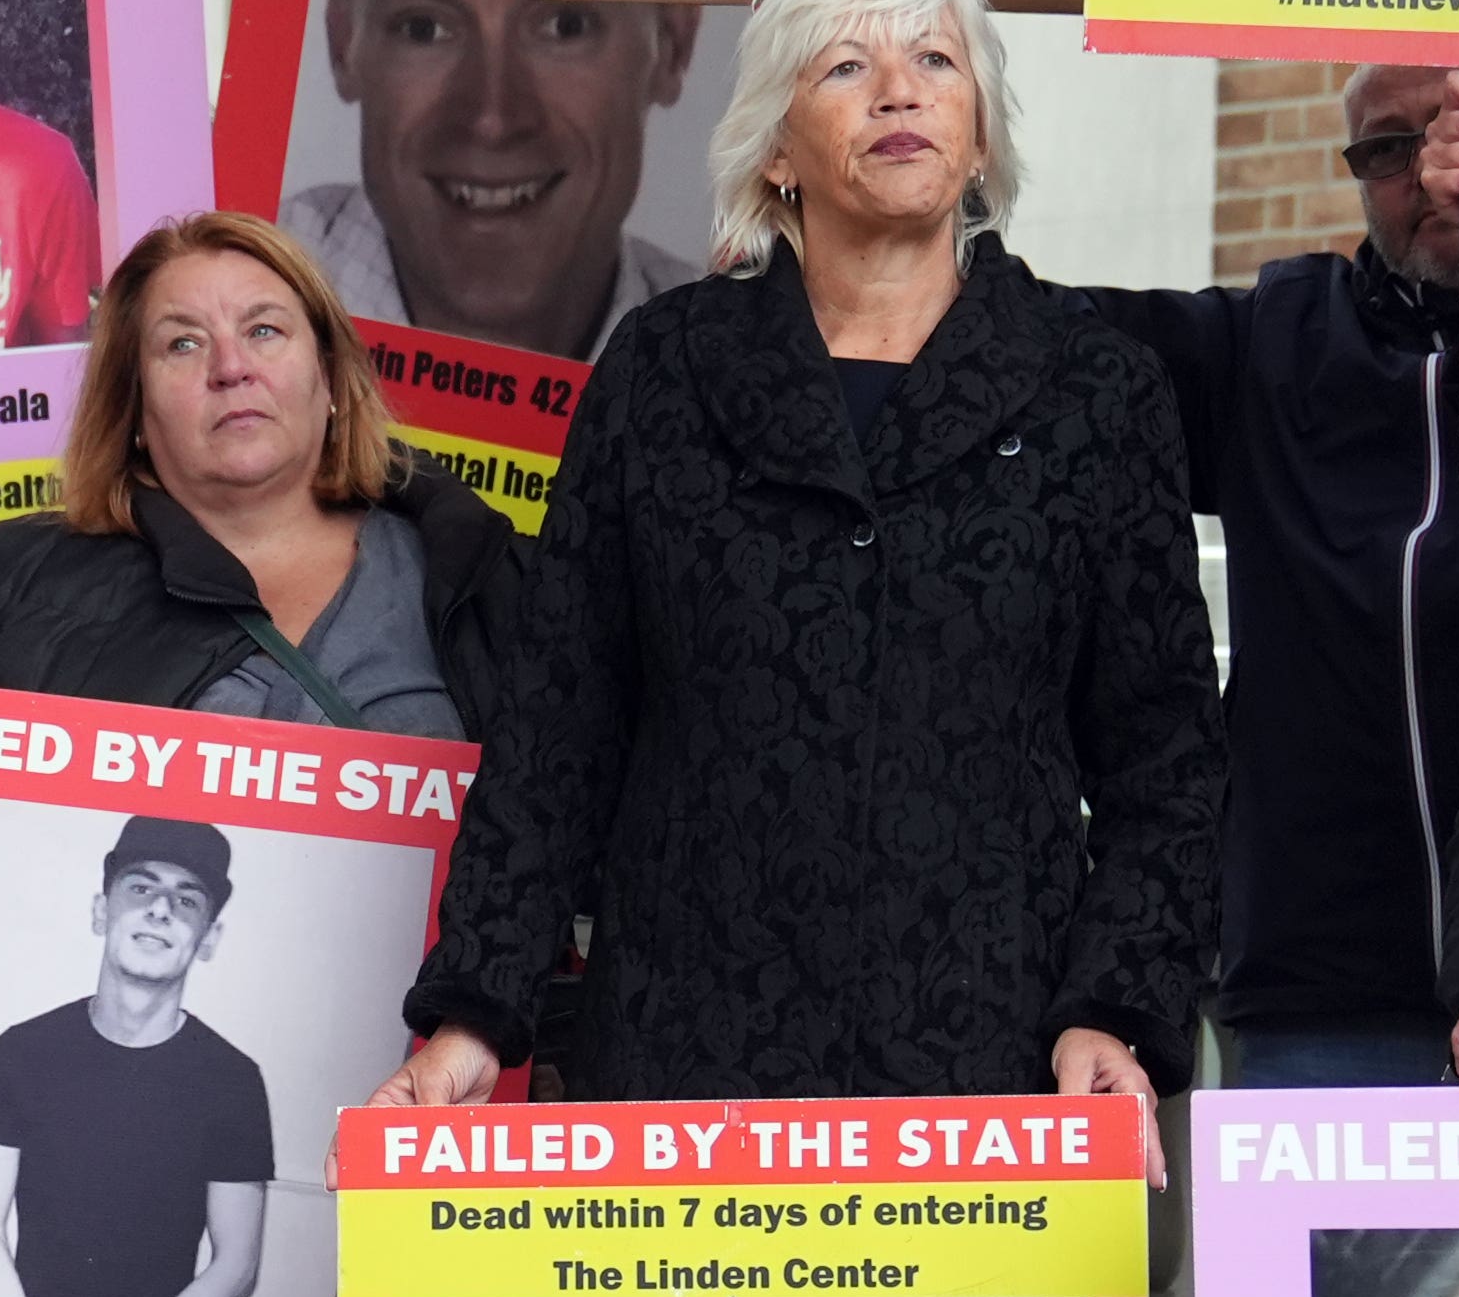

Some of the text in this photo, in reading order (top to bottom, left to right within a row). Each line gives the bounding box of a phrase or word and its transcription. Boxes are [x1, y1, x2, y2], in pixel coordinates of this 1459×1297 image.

[411, 350, 576, 423] Peters 42
[384, 1117, 1089, 1174] FAILED BY THE STATE
[431, 1193, 1048, 1234] Dead within 7 days of entering
